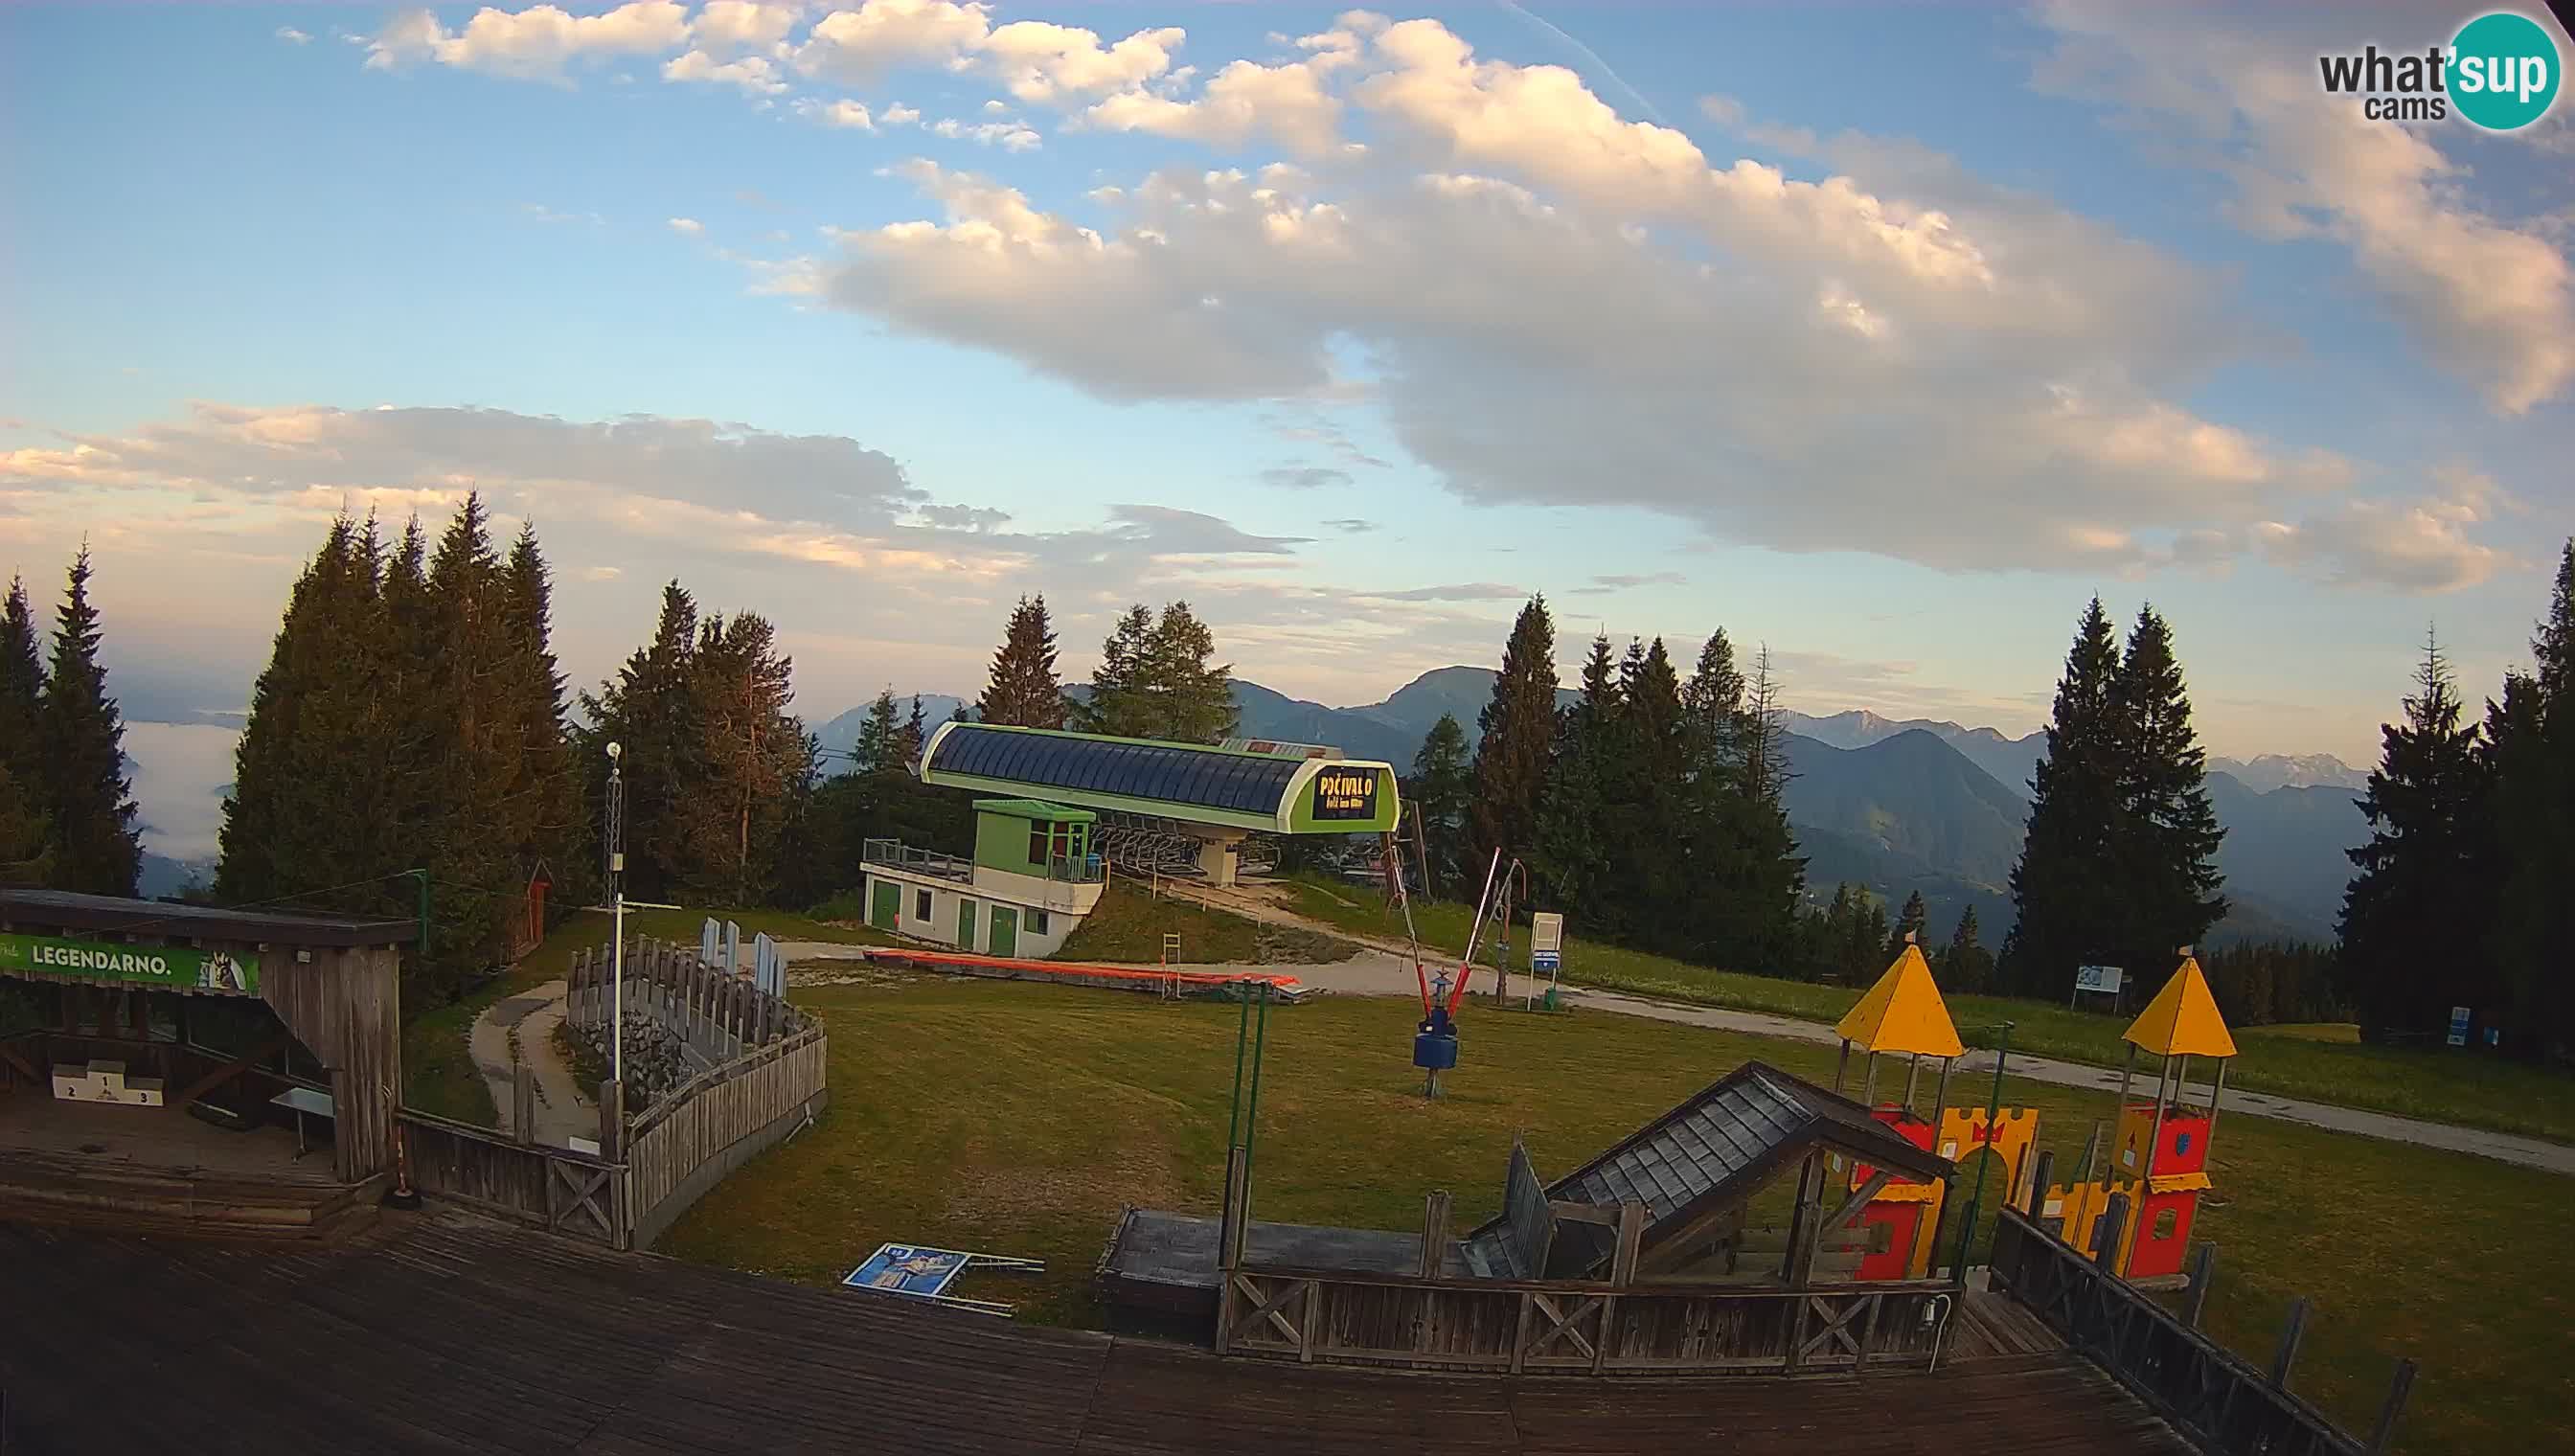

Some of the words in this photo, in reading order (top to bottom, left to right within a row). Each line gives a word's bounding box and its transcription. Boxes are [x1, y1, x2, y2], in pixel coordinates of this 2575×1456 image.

[32, 944, 171, 975] LEGENDARNO.
[103, 1076, 108, 1086] 1
[68, 1086, 76, 1097] 2
[140, 1092, 148, 1103] 3
